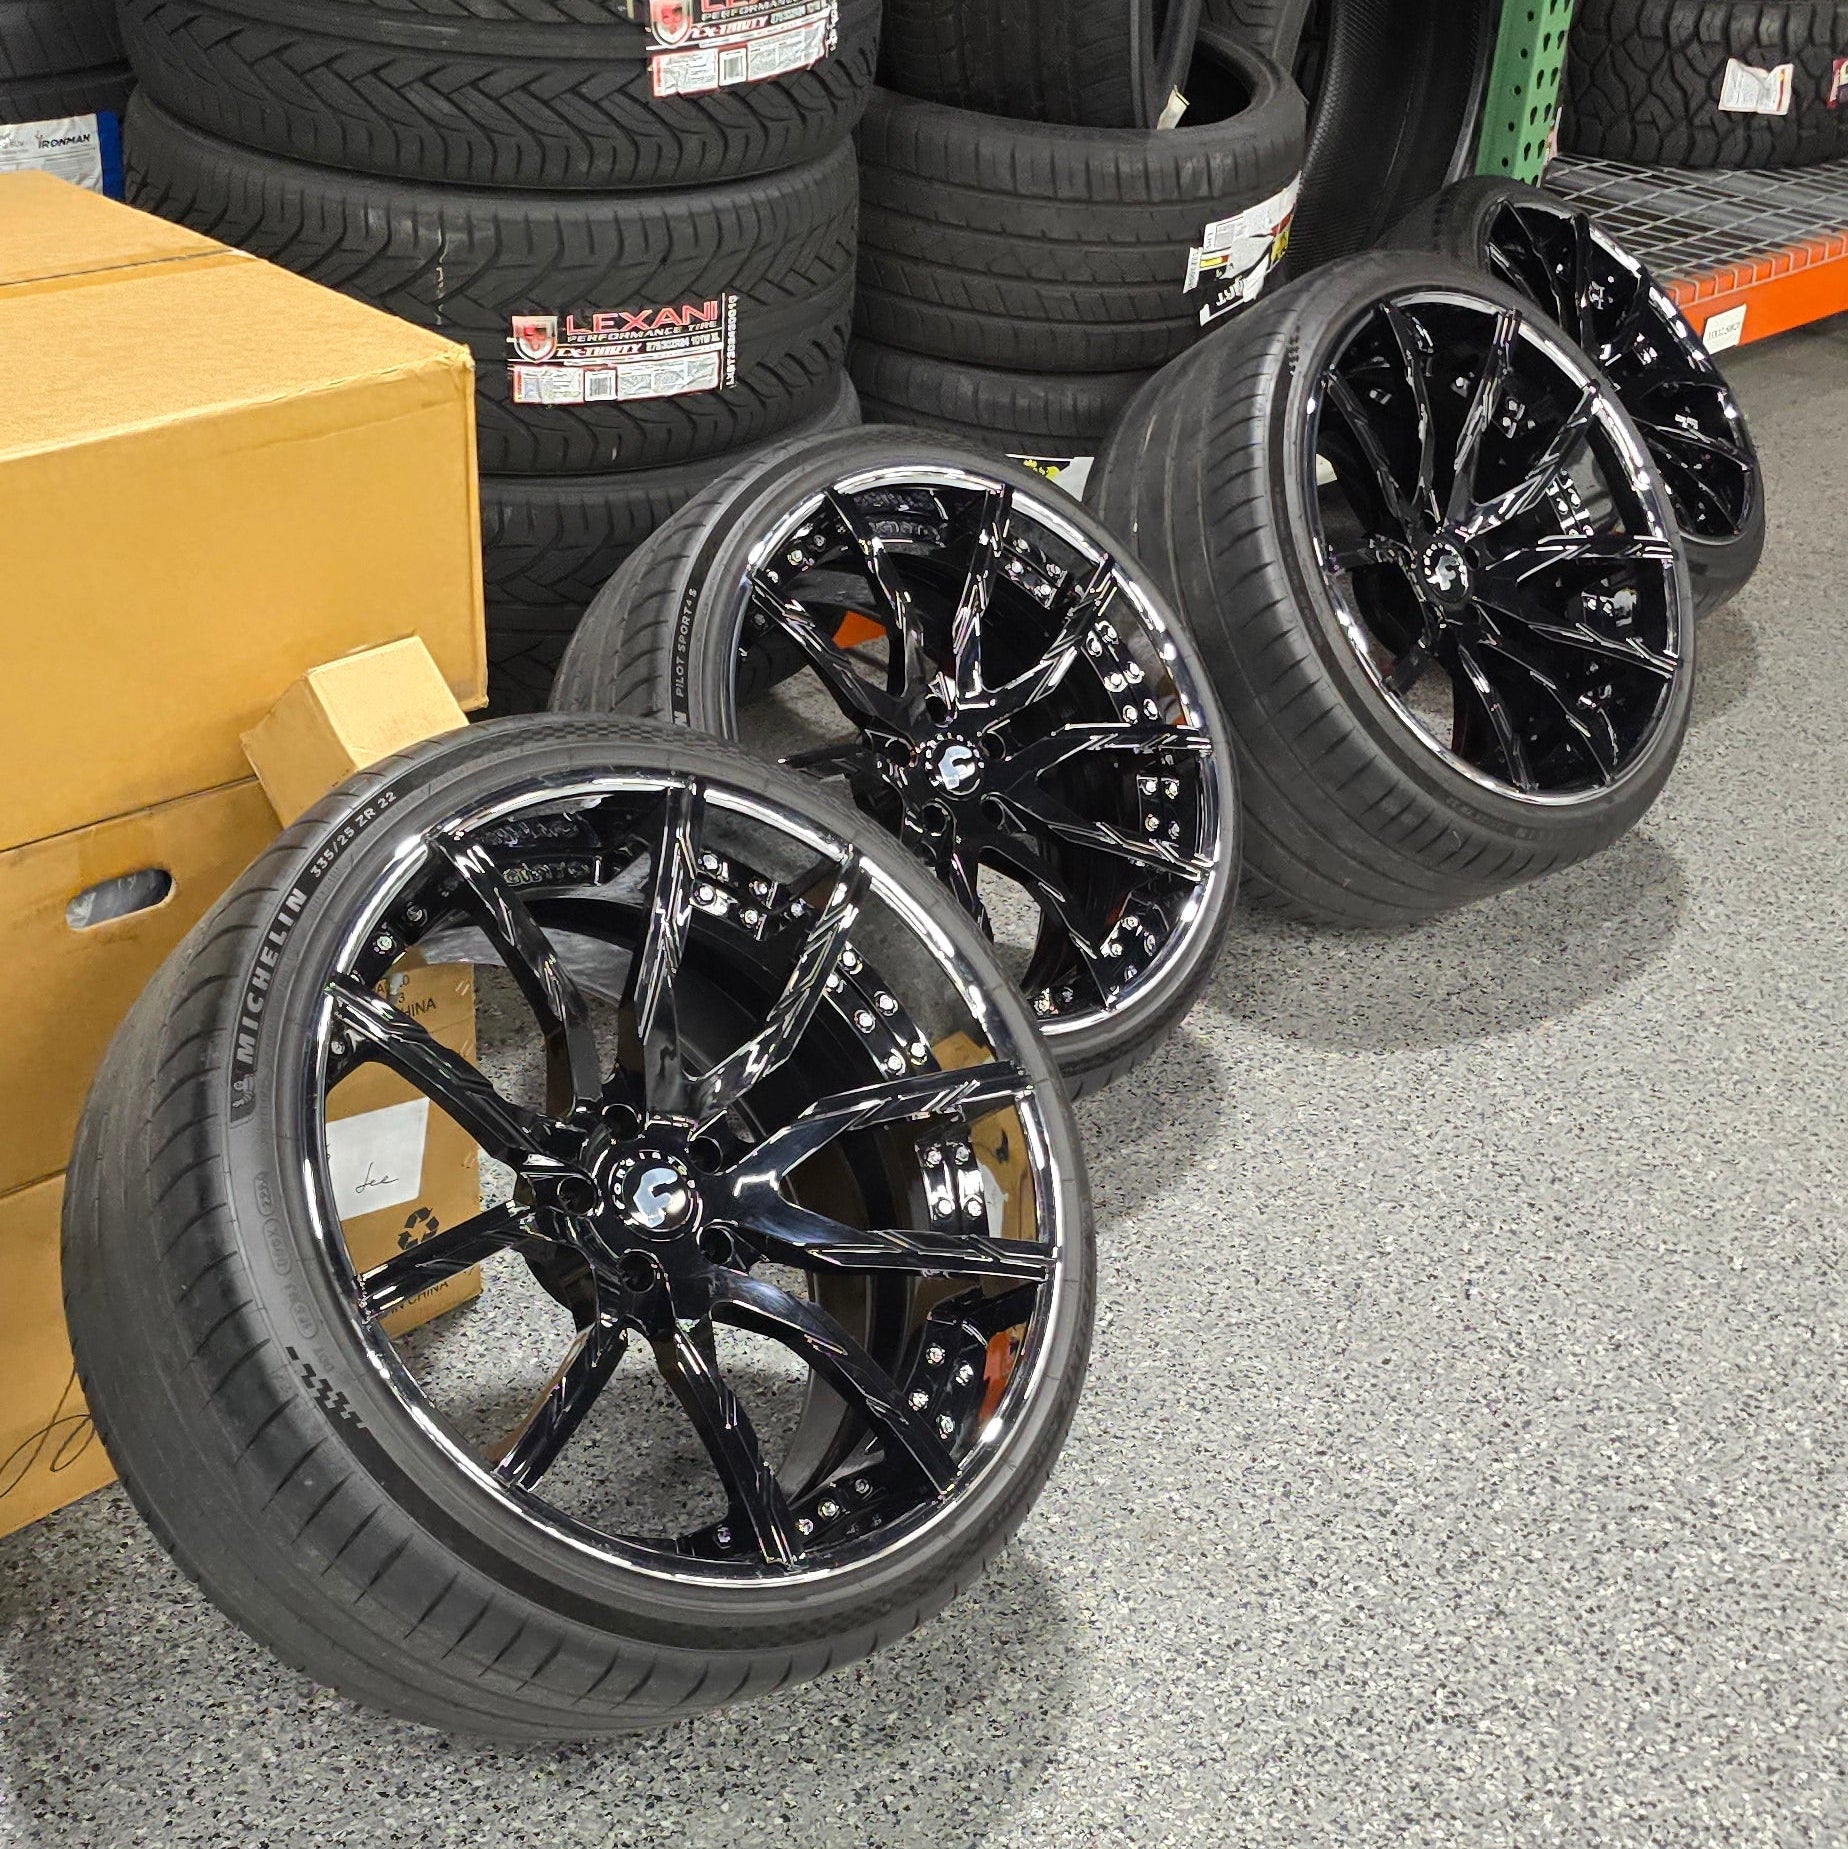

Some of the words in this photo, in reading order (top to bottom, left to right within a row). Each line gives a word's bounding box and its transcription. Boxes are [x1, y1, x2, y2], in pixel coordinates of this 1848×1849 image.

[38, 133, 91, 149] IRONMAN
[566, 300, 718, 335] LEXANI
[567, 326, 682, 342] PERFORMANCE
[677, 608, 693, 652] SPORT
[675, 656, 685, 698] PILOT
[236, 887, 308, 1066] MICHELIN
[310, 827, 355, 879] 335/25
[355, 807, 377, 828] ZR
[377, 790, 397, 809] 22
